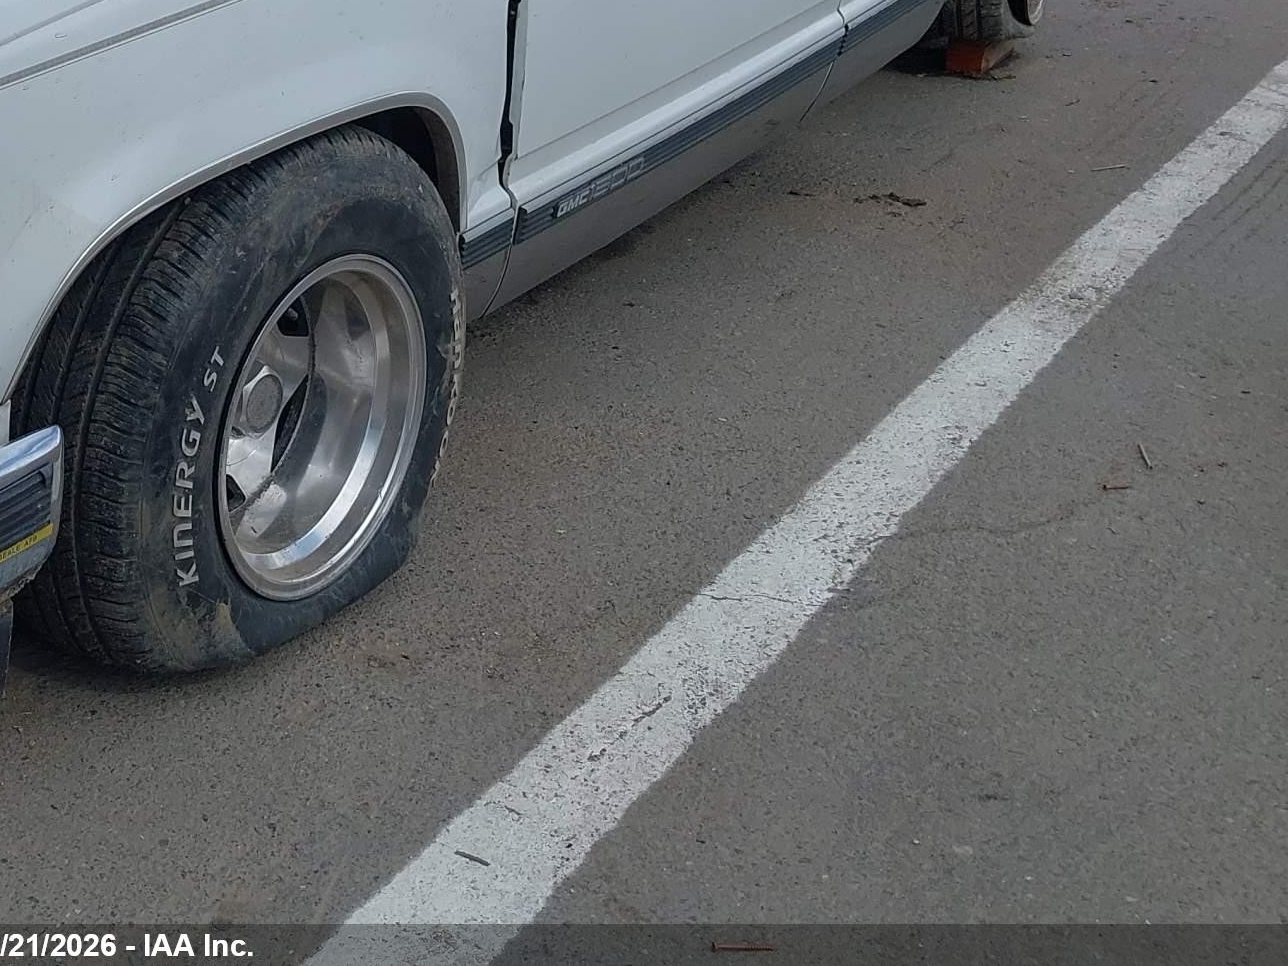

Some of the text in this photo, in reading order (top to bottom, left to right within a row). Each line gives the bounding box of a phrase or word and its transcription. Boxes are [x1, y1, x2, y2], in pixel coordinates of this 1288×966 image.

[556, 189, 589, 219] GMC
[173, 345, 225, 587] KINERGY ST
